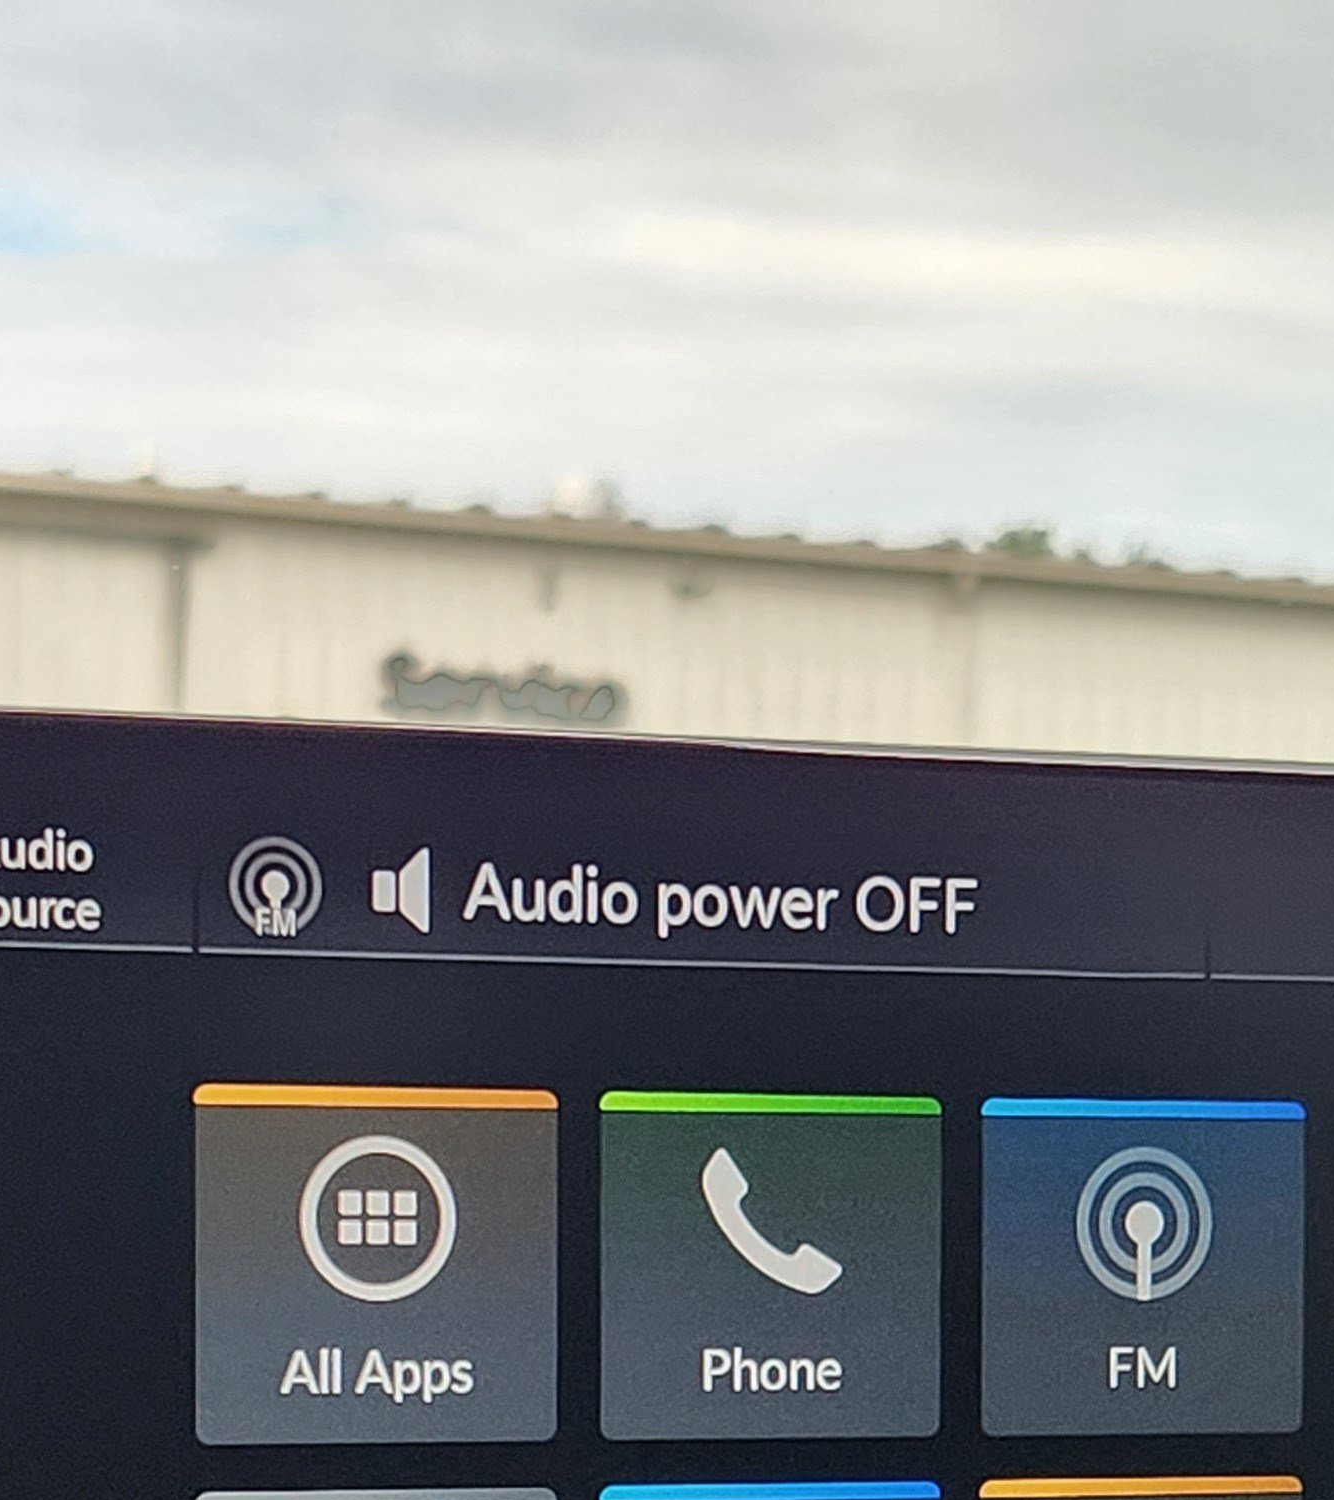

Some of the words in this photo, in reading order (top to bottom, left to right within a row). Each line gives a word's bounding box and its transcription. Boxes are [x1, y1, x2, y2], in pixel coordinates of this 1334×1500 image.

[254, 906, 297, 937] FM
[462, 861, 639, 925] Audio
[657, 878, 840, 940] power
[855, 874, 979, 935] OFF
[279, 1346, 343, 1395] All
[353, 1348, 475, 1404] Apps
[702, 1345, 843, 1393] Phone
[1108, 1345, 1178, 1390] FM
